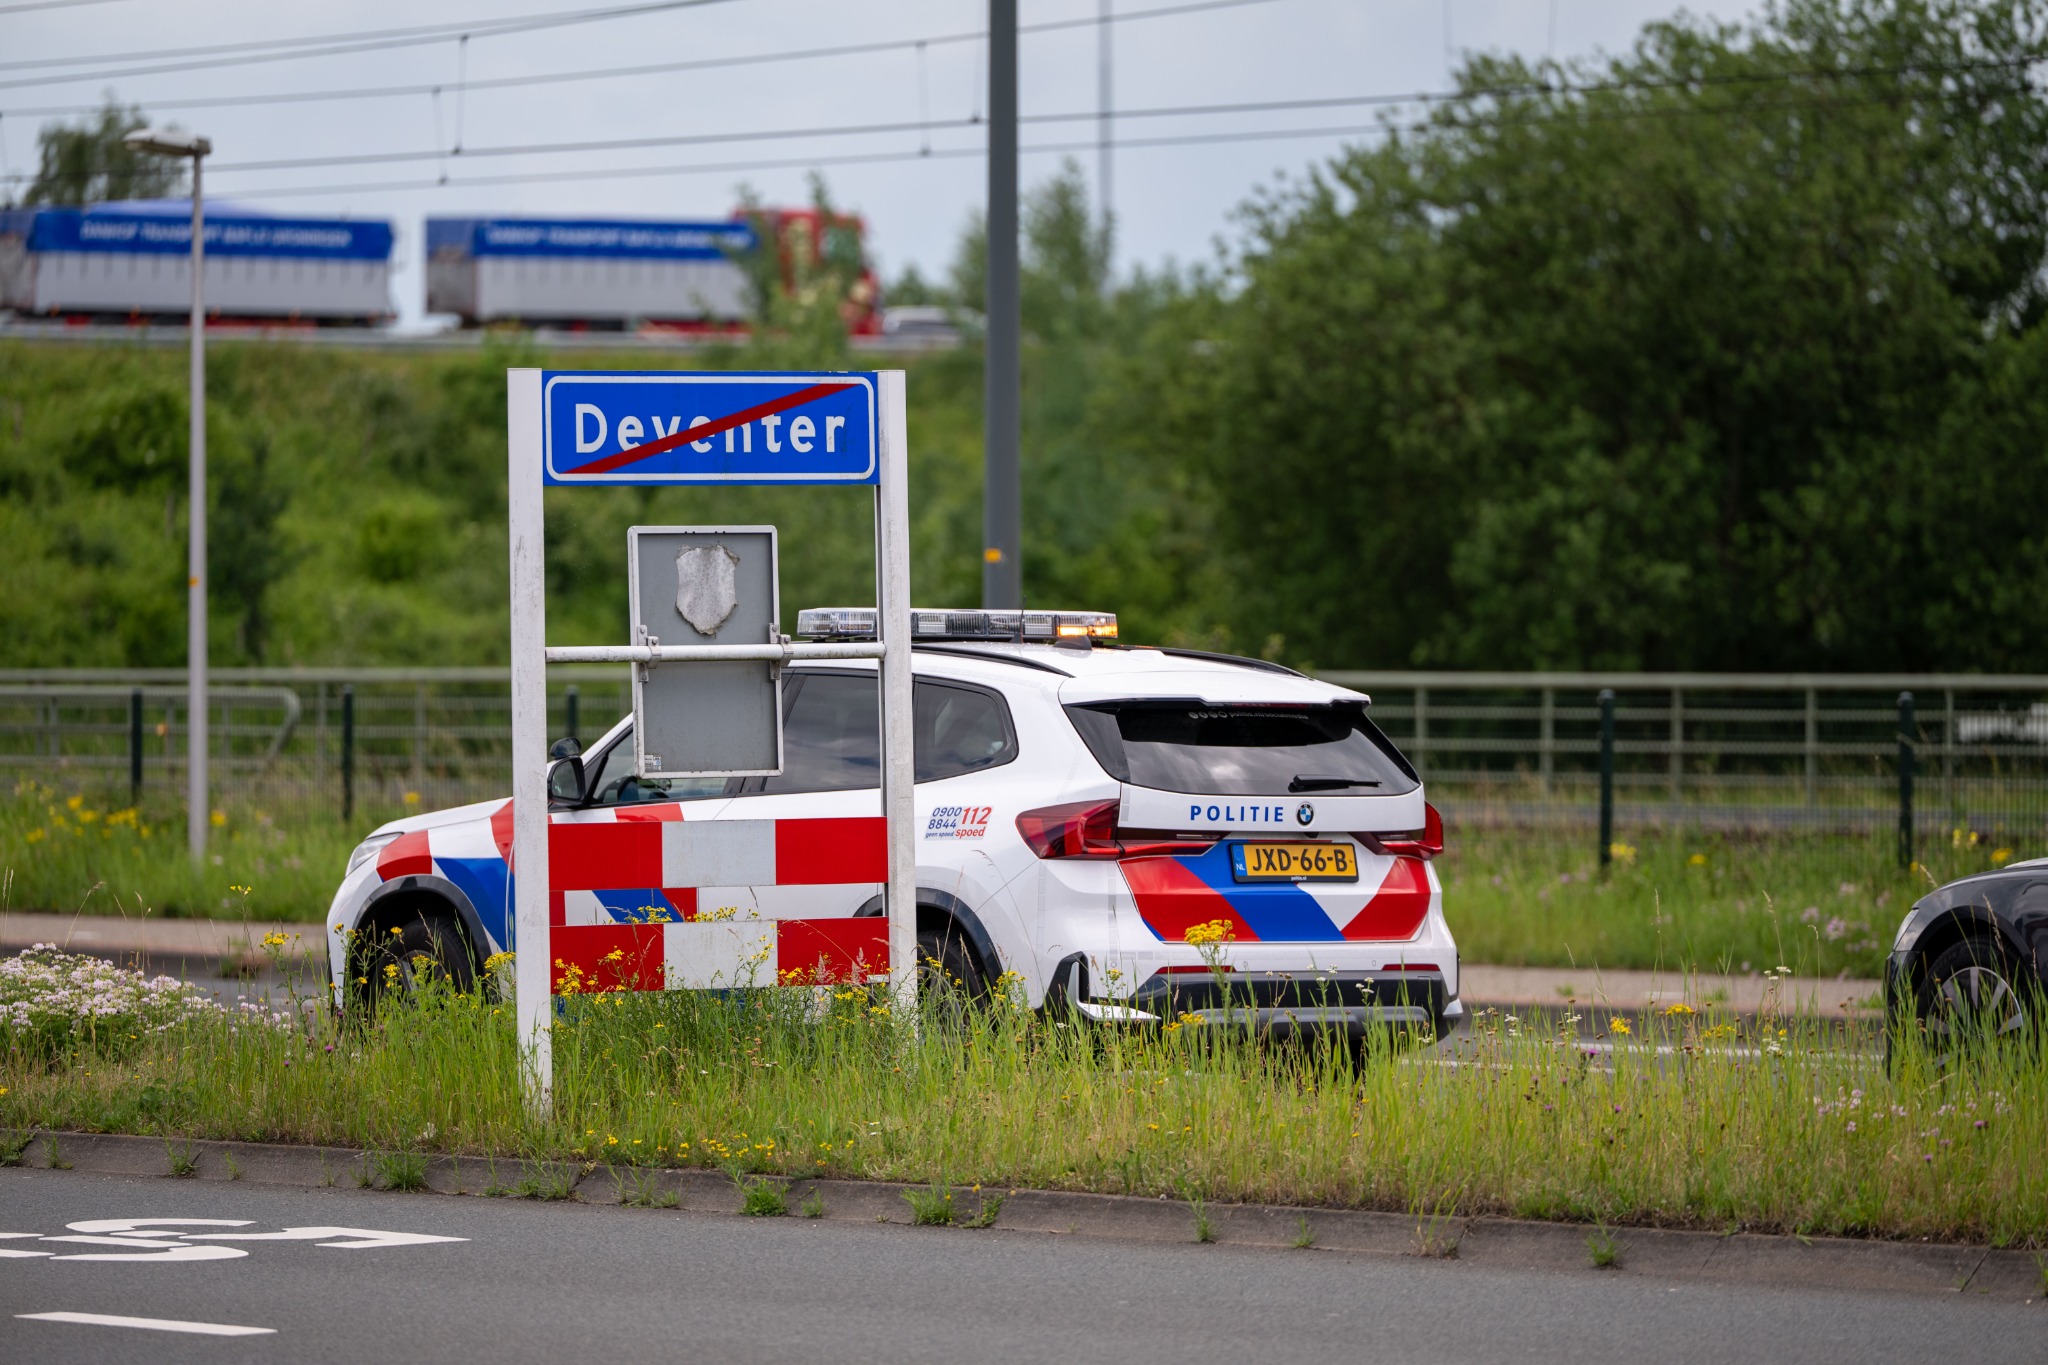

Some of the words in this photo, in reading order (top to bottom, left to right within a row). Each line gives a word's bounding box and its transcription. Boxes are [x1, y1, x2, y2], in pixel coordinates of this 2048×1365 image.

[575, 403, 846, 453] Deventer
[932, 807, 962, 817] 0900
[961, 806, 992, 825] 112
[1190, 805, 1284, 822] POLITIE
[928, 819, 957, 829] 8844
[955, 826, 986, 839] spoed
[1236, 863, 1245, 871] NL
[1252, 848, 1348, 872] JXD-66-B
